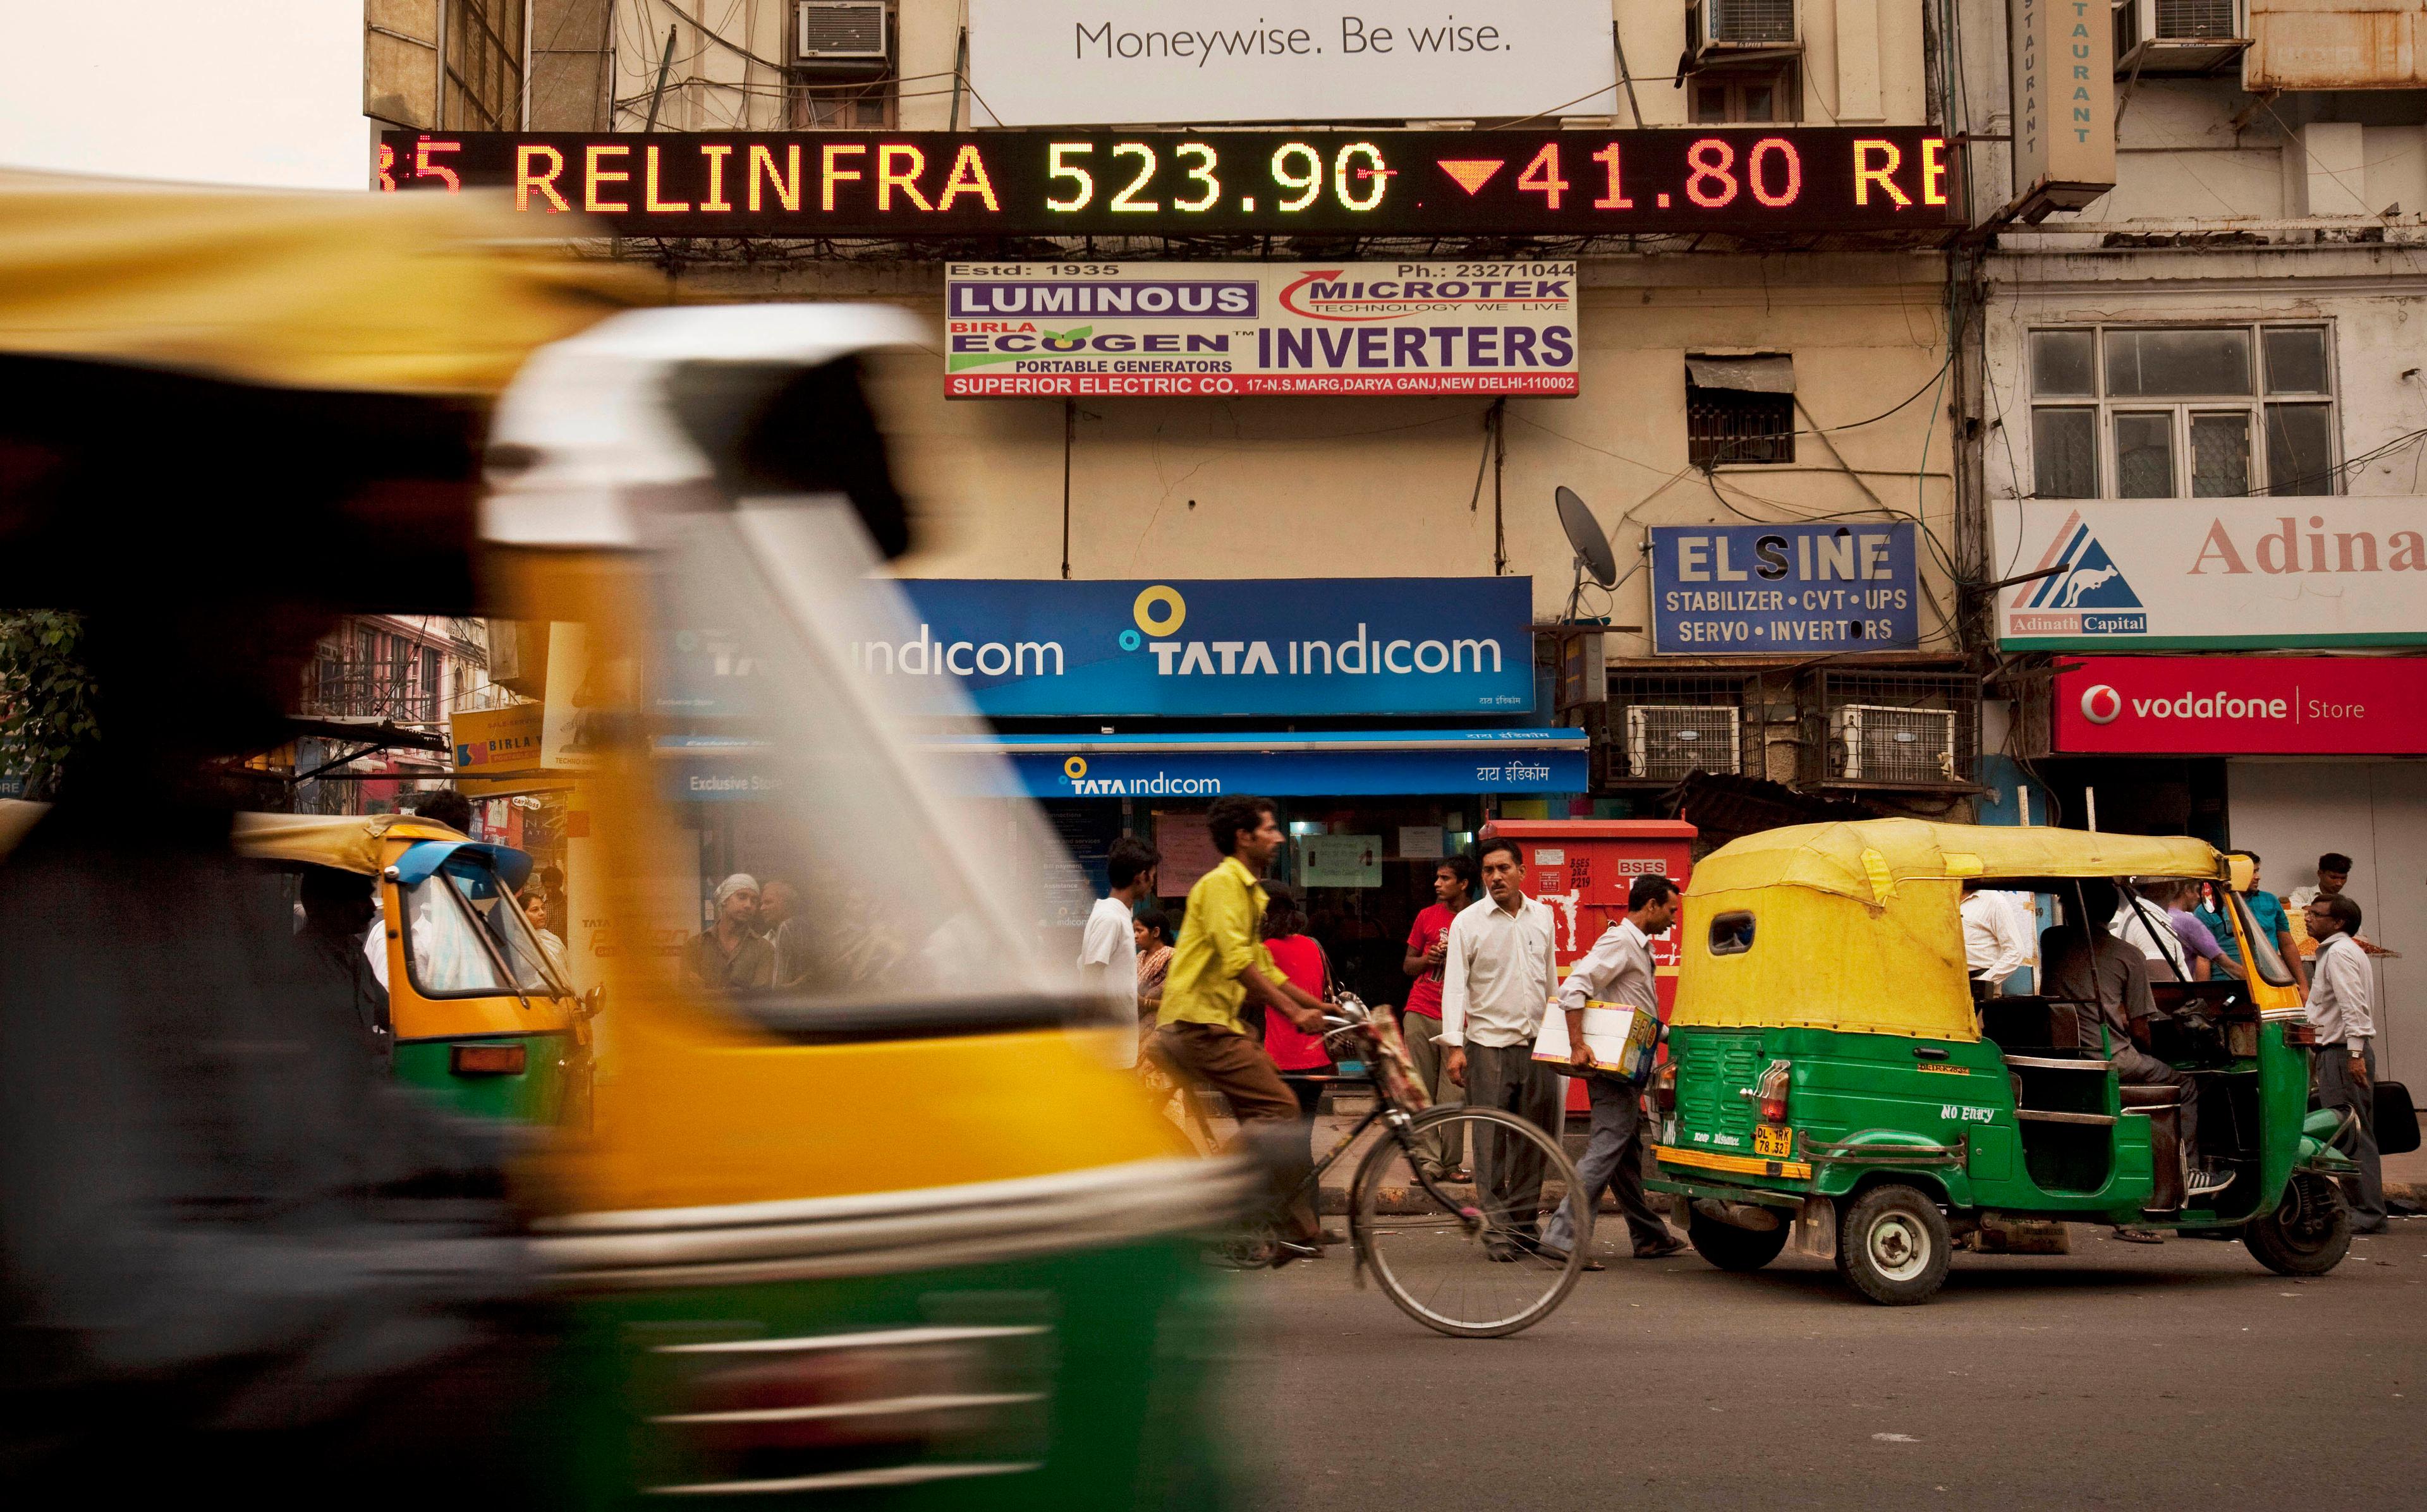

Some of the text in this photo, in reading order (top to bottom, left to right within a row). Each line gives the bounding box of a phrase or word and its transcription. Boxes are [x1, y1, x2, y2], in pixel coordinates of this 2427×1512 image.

[1075, 15, 1511, 67] Moneywise. Be wise.
[516, 144, 1000, 212] RELINFRA
[1046, 142, 1386, 213] 523.90
[1517, 138, 1801, 209] 41.80
[950, 264, 1120, 275] Estd: 1935
[1397, 263, 1576, 277] Ph.: 23271044
[961, 287, 1250, 312] LUMINOUS
[1309, 281, 1571, 299] MICROTEK
[1311, 303, 1461, 312] TECHNOLOGY
[1475, 303, 1509, 311] WE
[950, 322, 1037, 333] BIRLA
[952, 334, 1229, 353] ECOGEN
[1258, 325, 1574, 369] INVERTERS
[1016, 360, 1232, 373] PORTABLE GENERATORS
[952, 377, 1239, 394] SUPERIOR ELECTRIC CO.
[1478, 377, 1575, 390] DELHI-110002
[2186, 515, 2427, 575] Adina
[1677, 534, 1893, 582] ELSINE
[1667, 588, 1907, 612] STABILIZER CVT UPS
[1679, 620, 1749, 642] SERVO
[2013, 616, 2144, 633] Adinath Capital
[1149, 622, 1501, 675] TATA indicom
[2132, 691, 2365, 719] vodafone Store
[489, 736, 530, 751] BIRLA
[1476, 761, 1550, 783] टाटा इंडिकॉम
[1071, 771, 1220, 794] TATA indicom
[1619, 862, 1665, 873] BSES
[1759, 1140, 1784, 1154] 78 32
